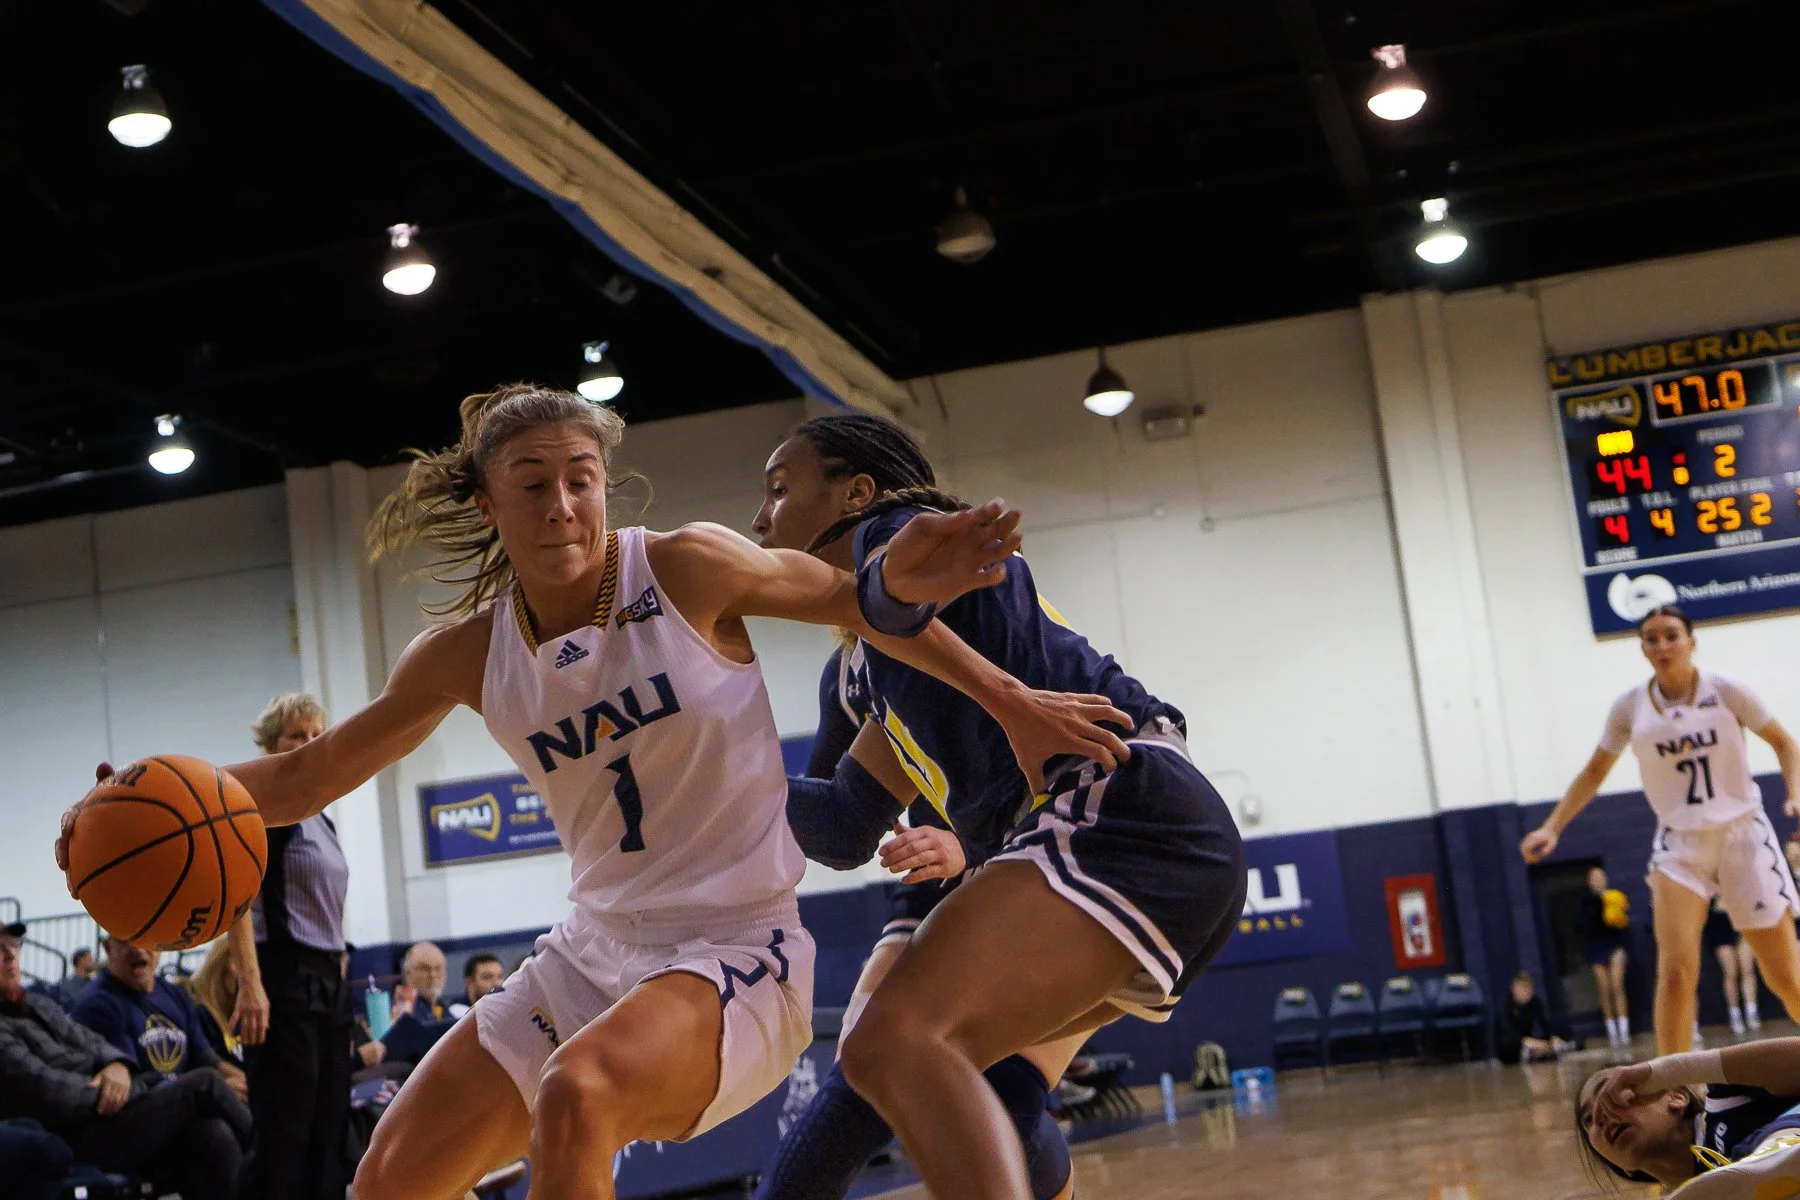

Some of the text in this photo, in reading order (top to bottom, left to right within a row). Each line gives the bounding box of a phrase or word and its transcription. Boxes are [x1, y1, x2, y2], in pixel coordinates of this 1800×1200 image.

[1576, 397, 1634, 420] NAU
[1653, 369, 1748, 416] 47.0
[1596, 455, 1653, 494] 44
[1714, 444, 1737, 478] 2
[1650, 508, 1675, 537] 4
[1696, 497, 1742, 534] 25
[1750, 491, 1773, 526] 2
[1604, 514, 1630, 543] 4
[555, 649, 590, 669] adidas
[526, 671, 681, 773] NAU
[1655, 728, 1719, 757] NAU
[1676, 755, 1716, 805] 21
[437, 804, 492, 834] NAU
[604, 753, 646, 853] 1
[1242, 863, 1301, 916] U
